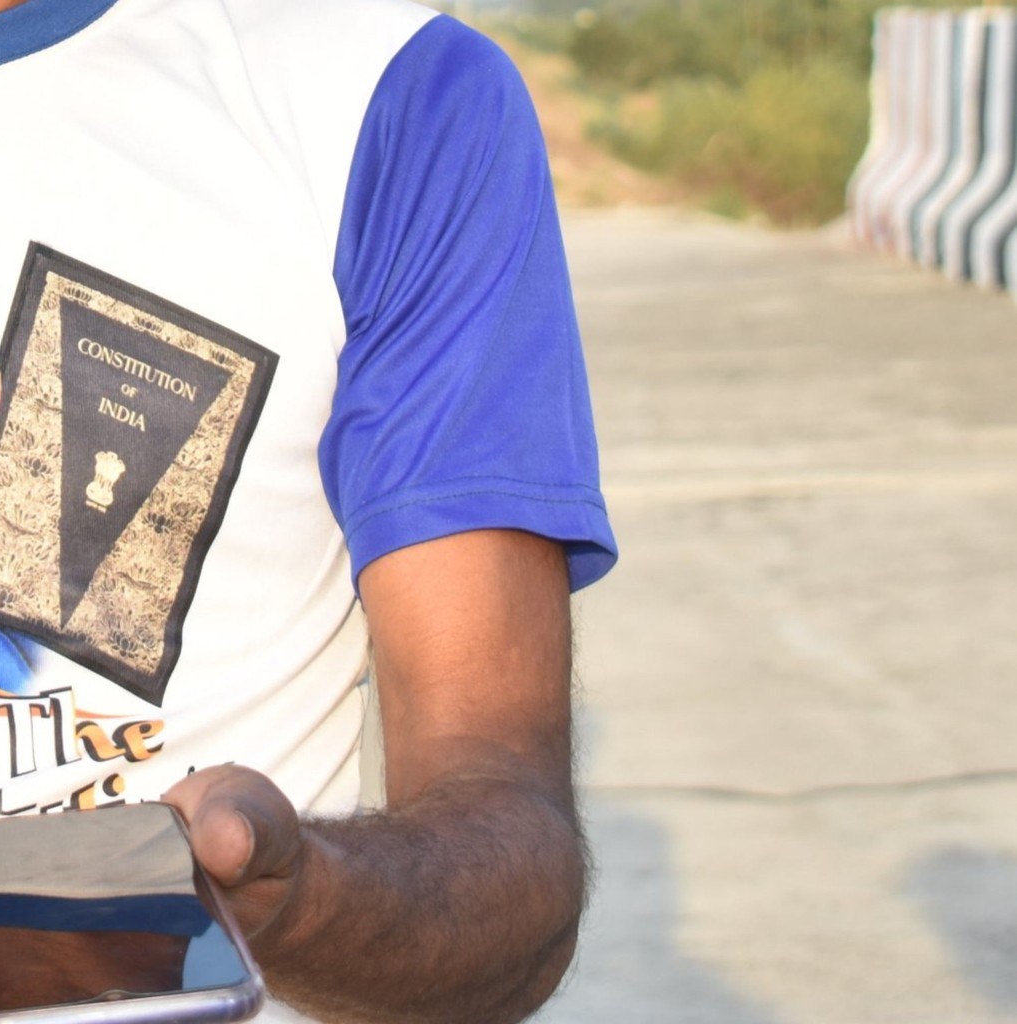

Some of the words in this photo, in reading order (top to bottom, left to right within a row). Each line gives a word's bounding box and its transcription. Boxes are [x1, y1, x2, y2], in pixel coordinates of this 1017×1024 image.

[77, 338, 196, 401] CONSTITUTION
[120, 383, 138, 397] OF
[98, 397, 145, 431] INDIA
